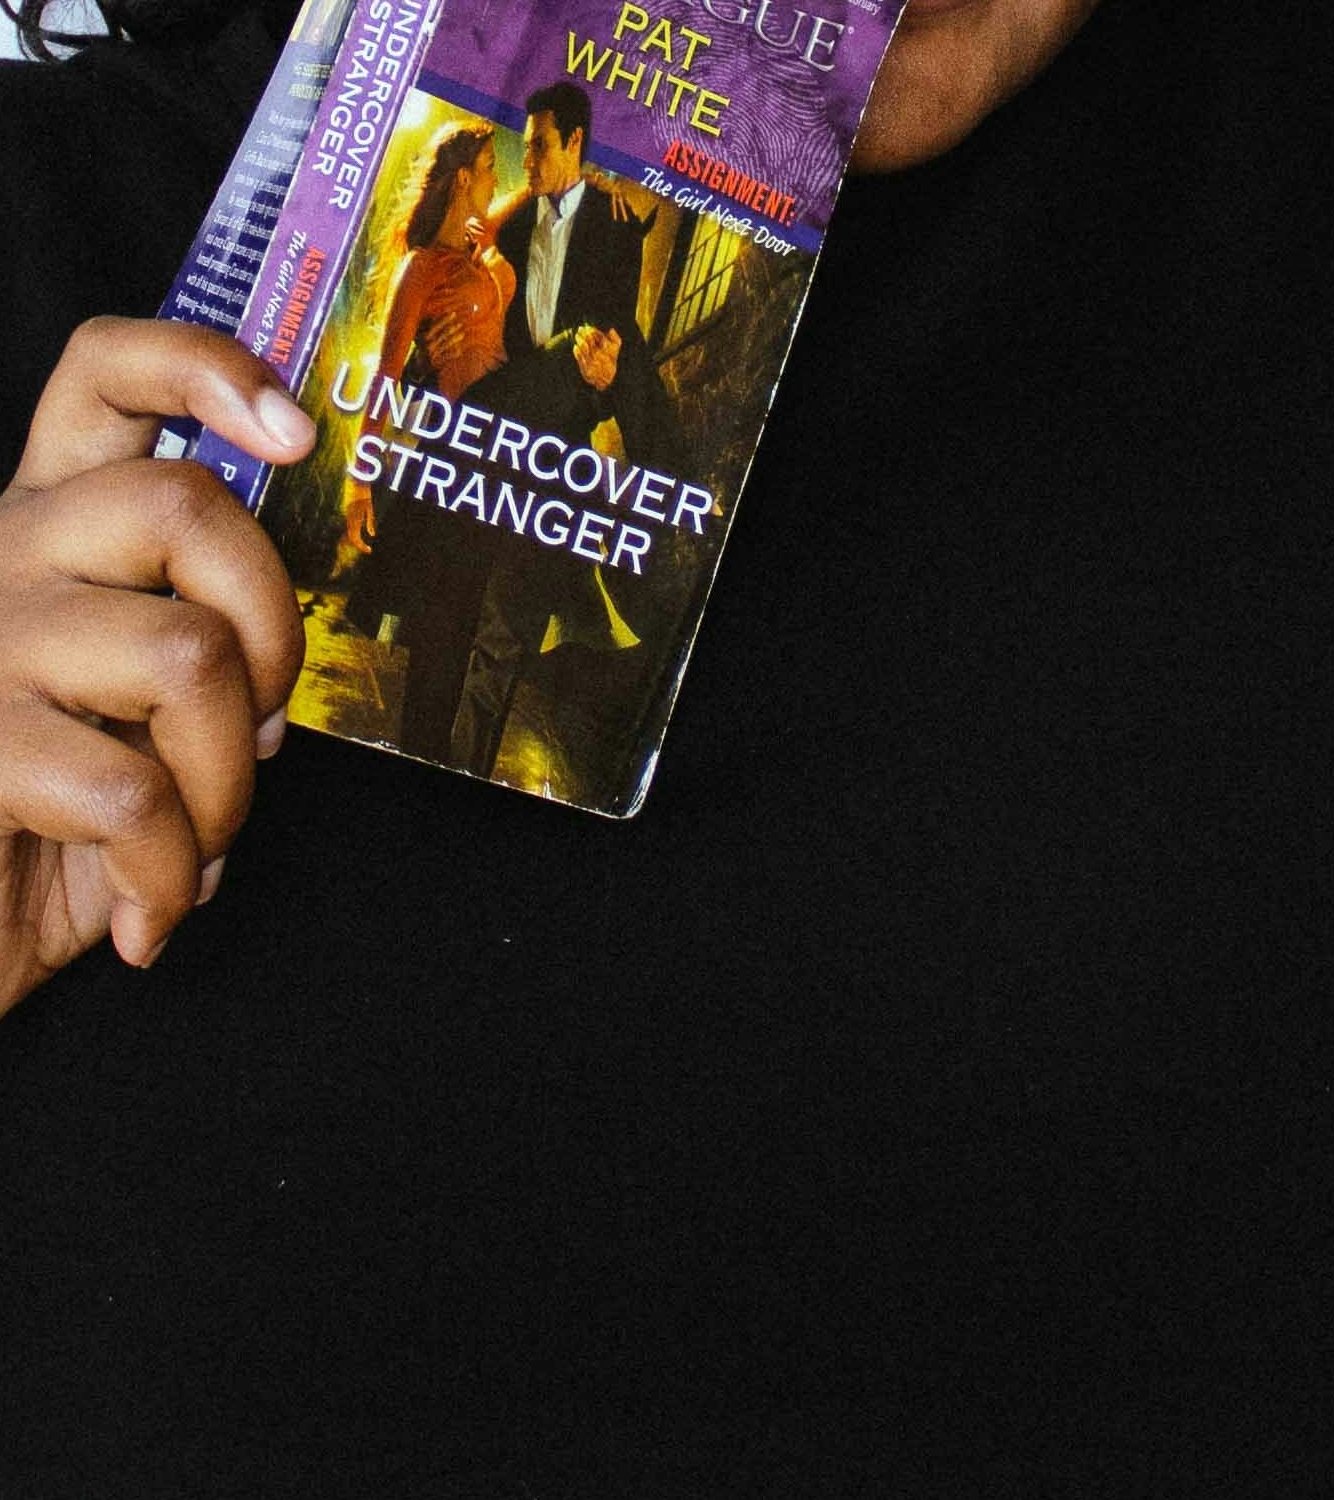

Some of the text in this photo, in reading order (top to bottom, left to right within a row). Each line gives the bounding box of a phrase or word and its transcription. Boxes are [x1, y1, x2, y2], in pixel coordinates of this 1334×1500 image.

[611, 0, 713, 72] PAT
[312, 0, 390, 179] STRANGER
[565, 30, 732, 139] WHITE
[639, 166, 800, 259] The Girl Next Door
[661, 138, 798, 228] ASSIGNMENT:
[276, 260, 296, 294] Girl
[290, 229, 307, 260] The
[330, 359, 716, 537] UNDERCOVER
[345, 433, 653, 576] STRANGER
